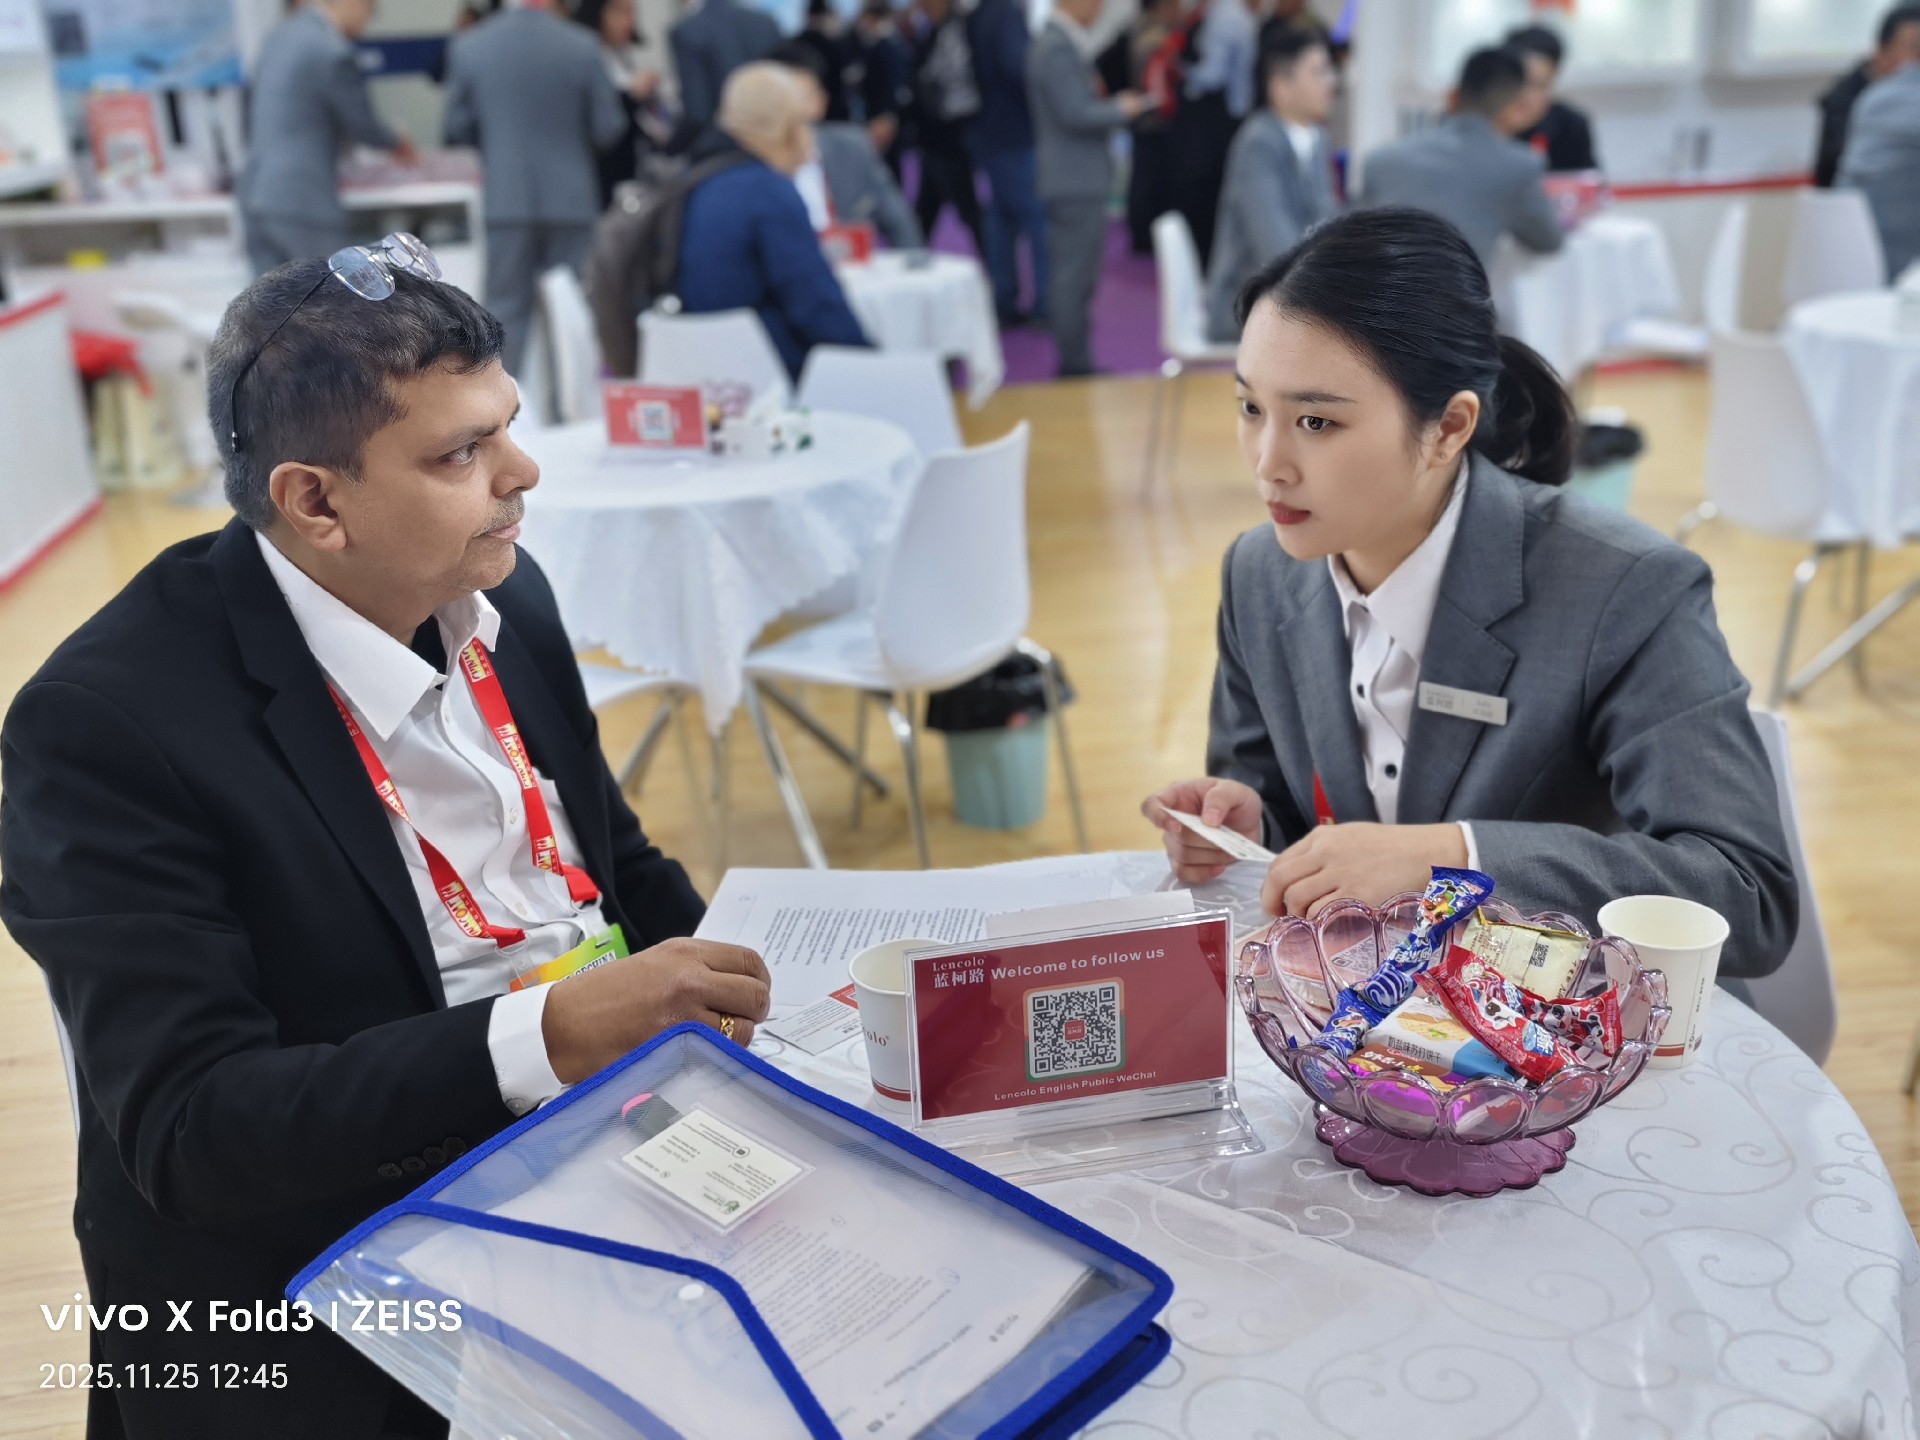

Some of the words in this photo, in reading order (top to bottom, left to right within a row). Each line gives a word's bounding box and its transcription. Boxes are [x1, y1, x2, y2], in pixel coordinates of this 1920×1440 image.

[462, 646, 487, 681] CHINAC
[932, 956, 985, 972] Lencolo
[991, 961, 1067, 980] Welcome
[1071, 958, 1088, 969] to
[1091, 951, 1142, 967] follow
[1145, 948, 1165, 959] us
[934, 968, 985, 989] 蓝柯路
[1387, 1036, 1441, 1063] 奶盐味苏打饼干
[994, 1089, 1037, 1101] Lencolo
[1039, 1082, 1079, 1095] English
[1081, 1078, 1115, 1088] Public
[1116, 1071, 1157, 1083] WeChat
